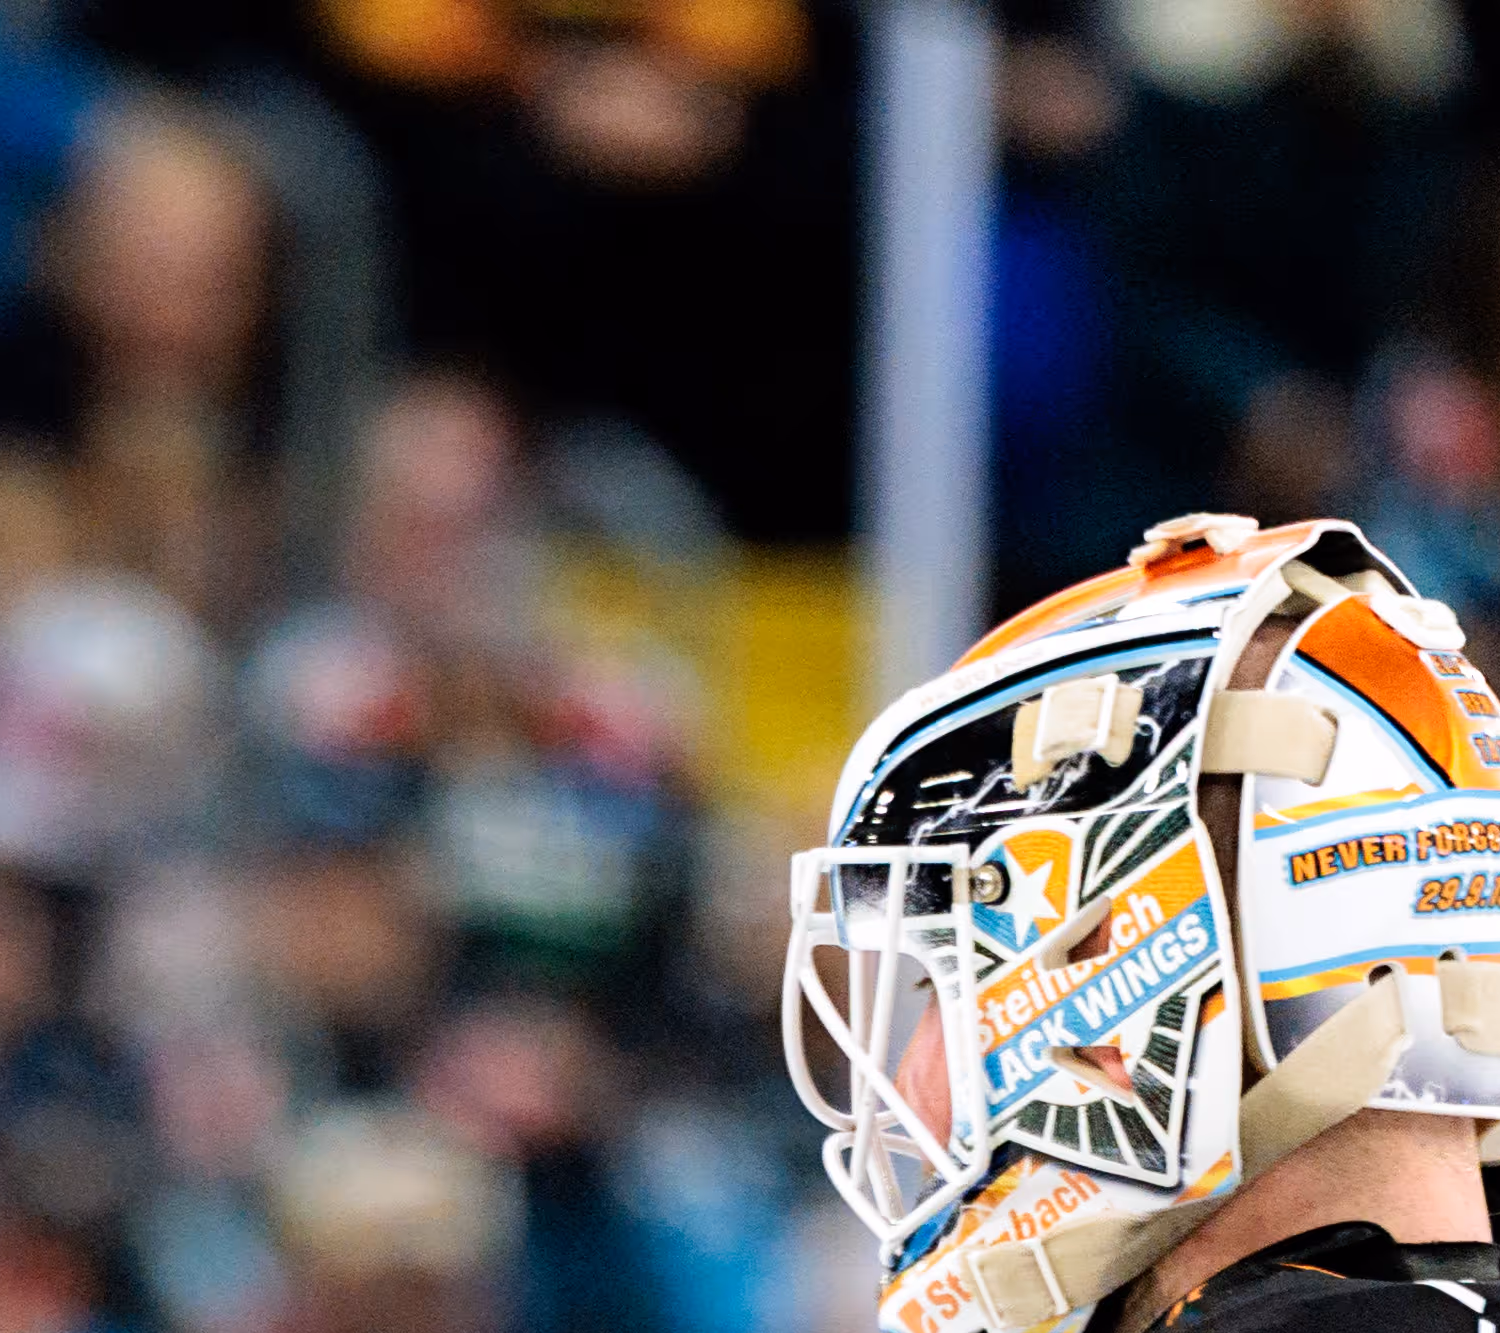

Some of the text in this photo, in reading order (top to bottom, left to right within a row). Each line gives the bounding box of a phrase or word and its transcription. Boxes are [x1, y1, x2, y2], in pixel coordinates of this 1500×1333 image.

[1289, 833, 1408, 885] NEVER
[977, 893, 1164, 1052] Steinch
[1073, 913, 1210, 1030] WINGS
